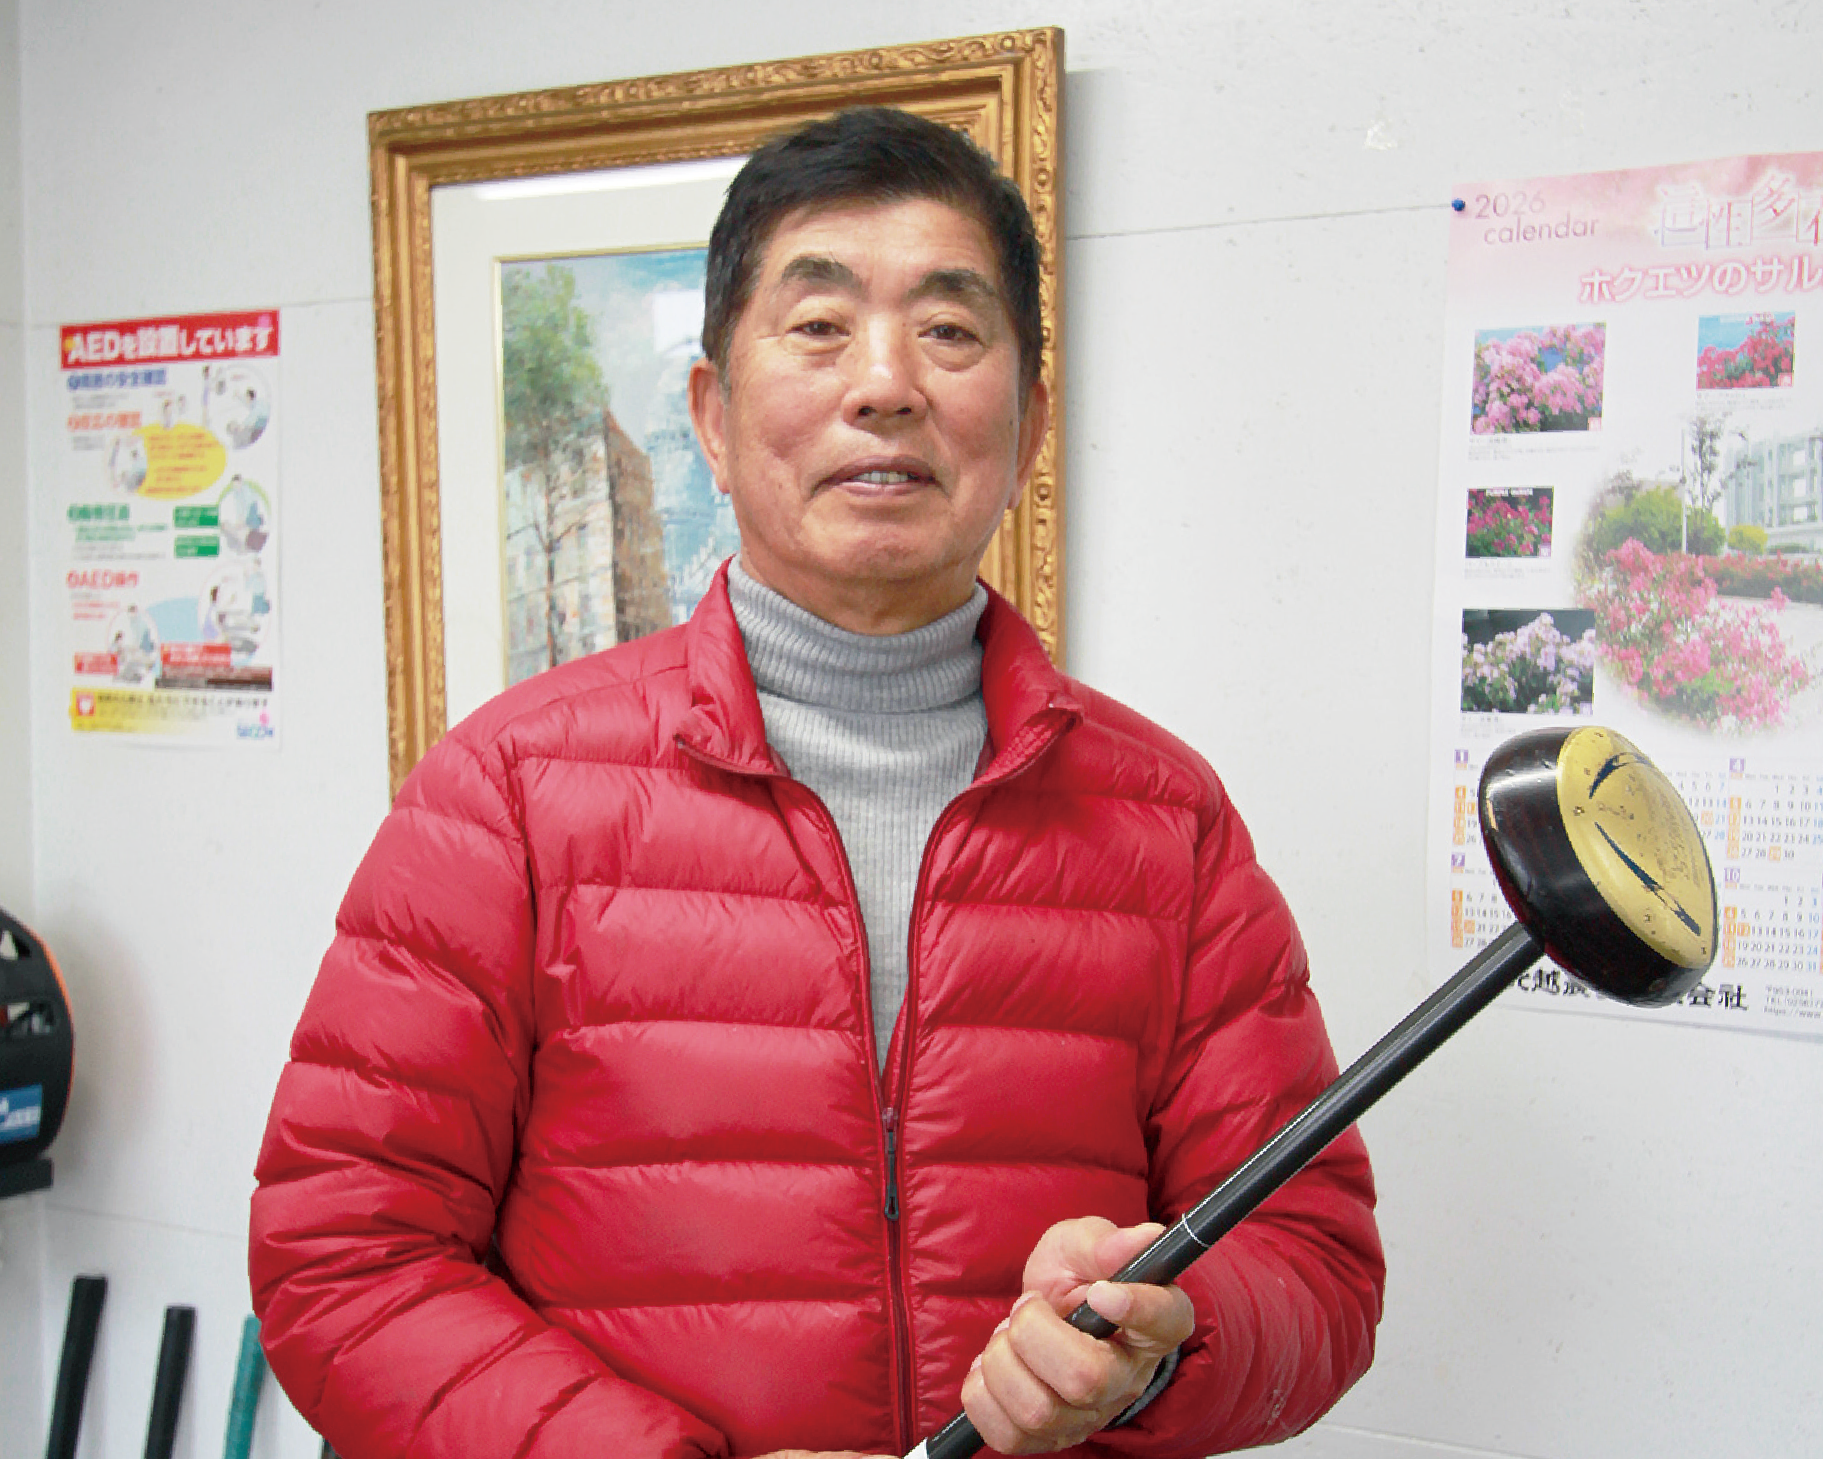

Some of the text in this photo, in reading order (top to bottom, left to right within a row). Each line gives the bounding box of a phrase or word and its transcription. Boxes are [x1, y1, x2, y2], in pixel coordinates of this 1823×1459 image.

[1475, 190, 1546, 219] 2026
[1484, 211, 1599, 245] calendar
[1809, 913, 1819, 924] 10
